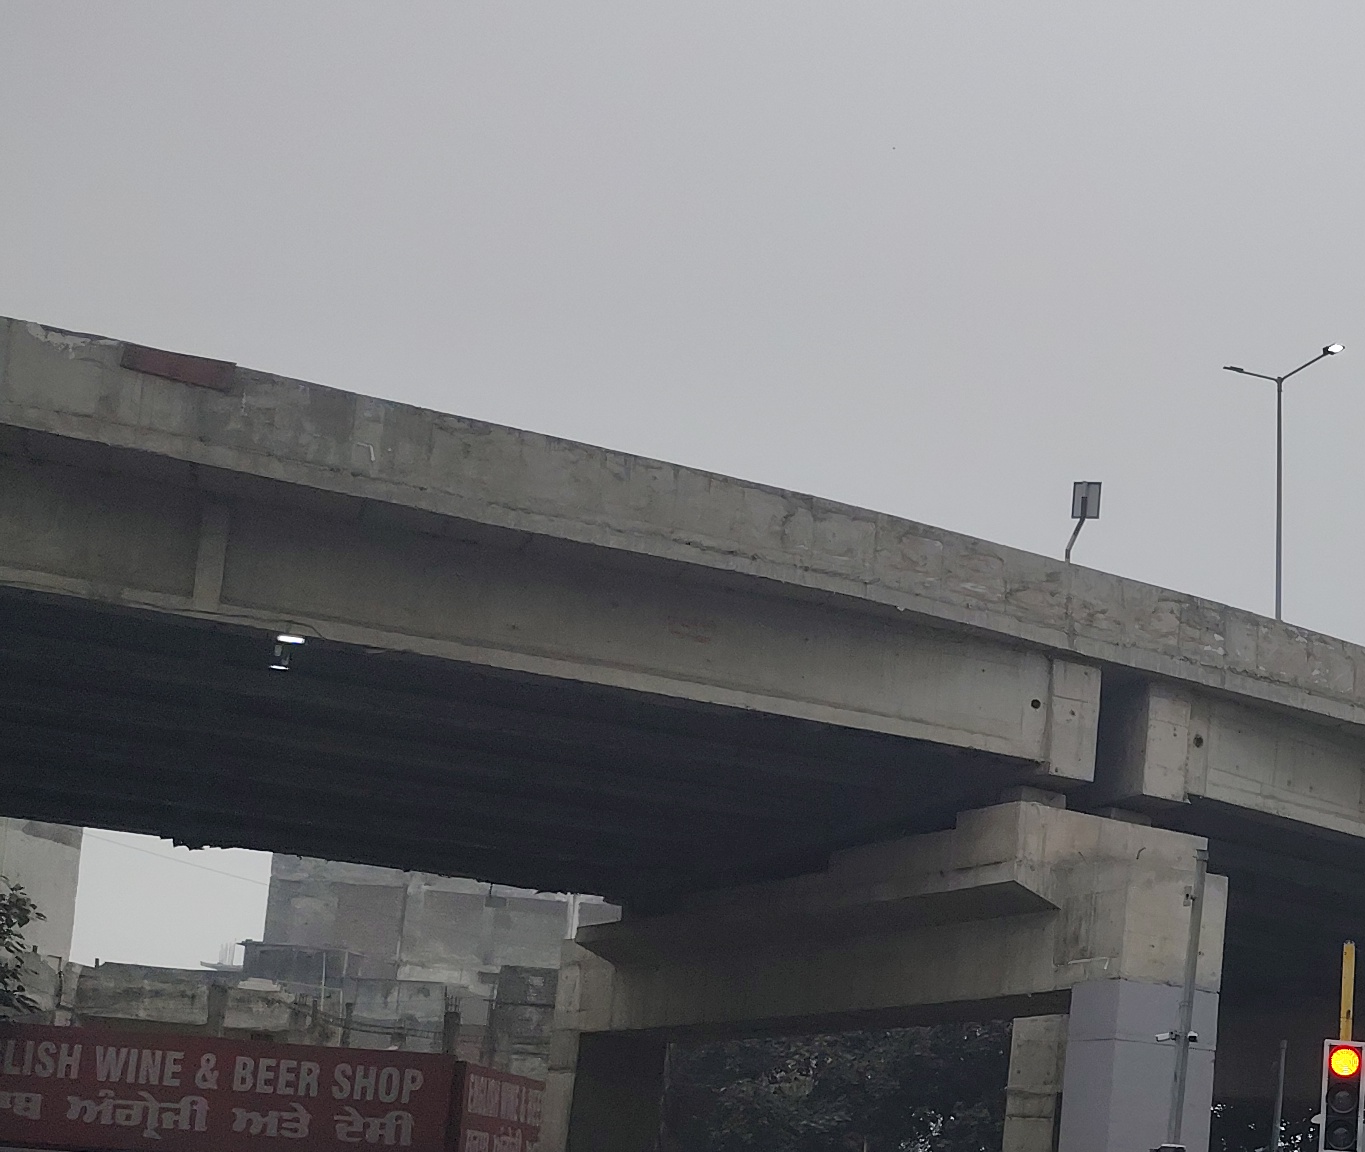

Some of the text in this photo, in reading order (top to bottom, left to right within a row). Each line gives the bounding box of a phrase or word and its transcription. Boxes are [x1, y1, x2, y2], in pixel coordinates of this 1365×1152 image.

[96, 1045, 185, 1087] WINE
[195, 1052, 219, 1089] &
[233, 1056, 320, 1097] BEER
[332, 1063, 424, 1104] SHOP
